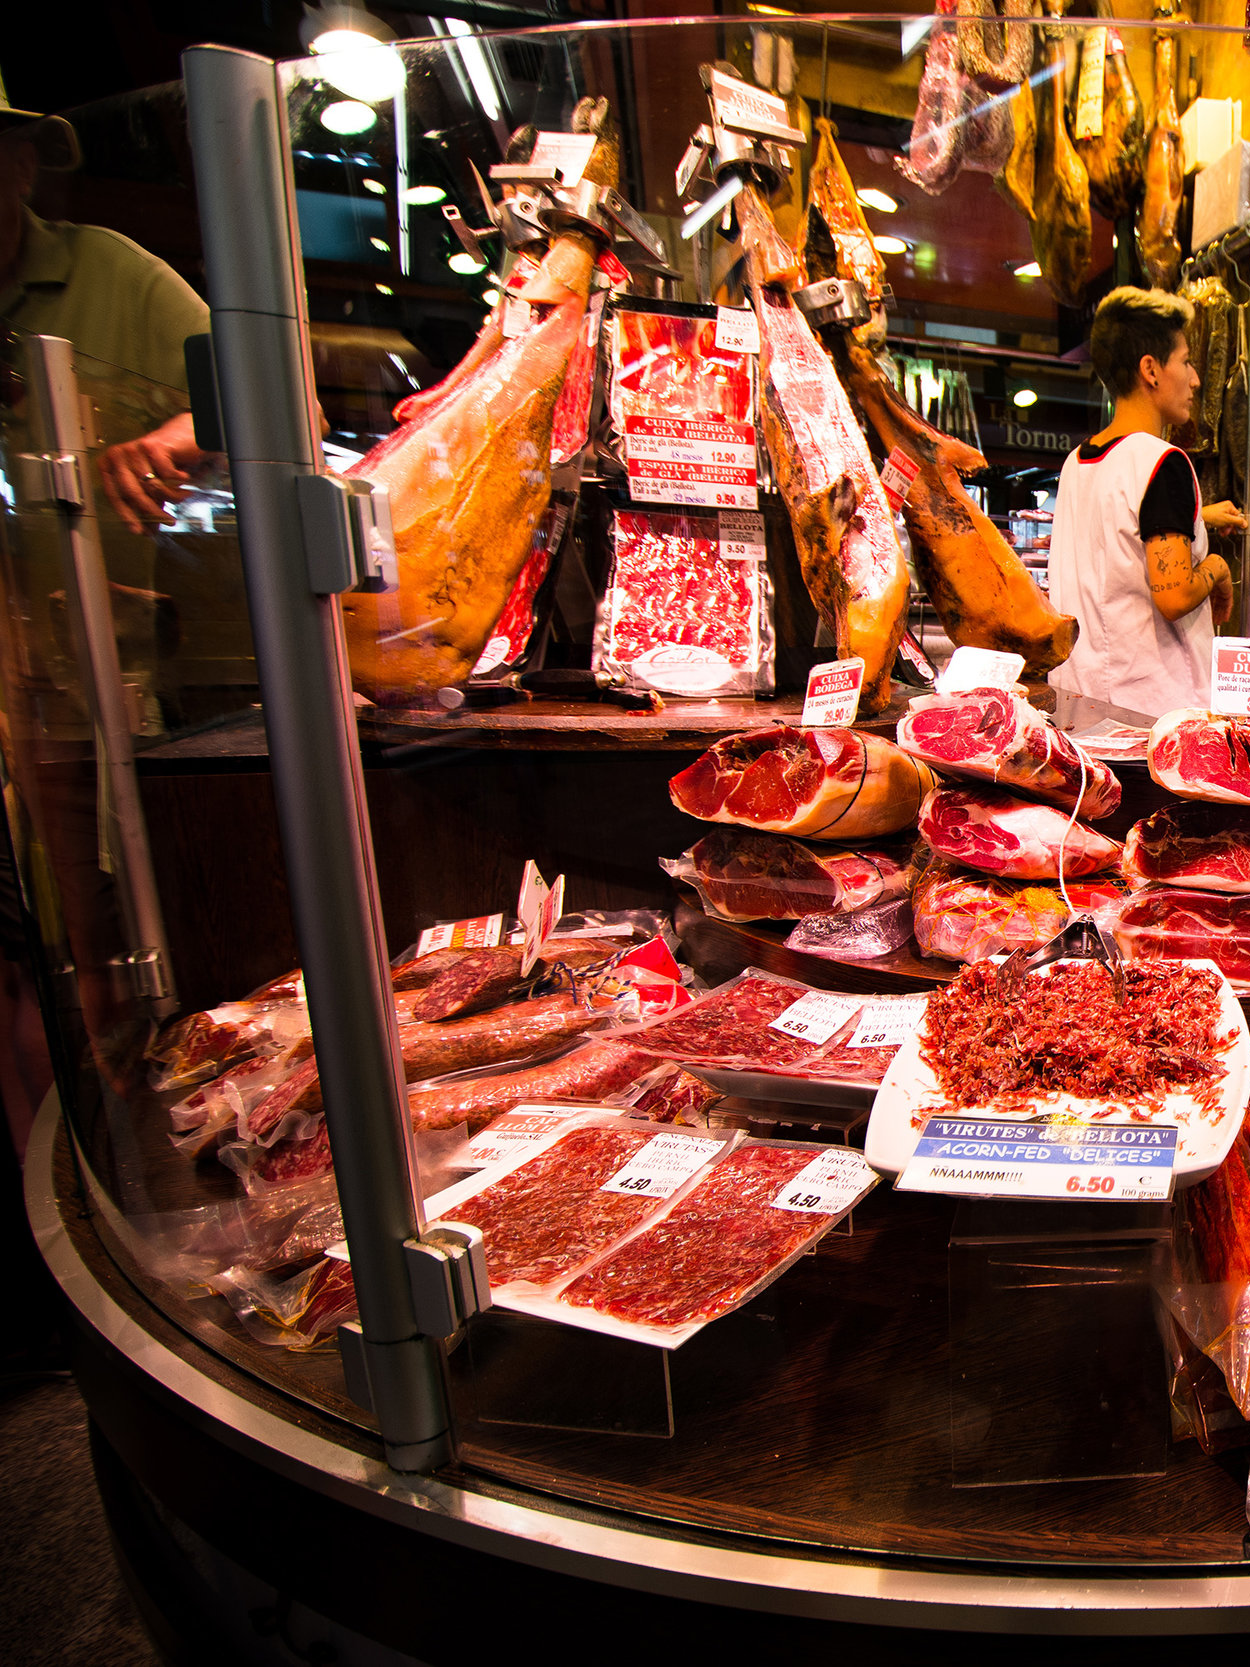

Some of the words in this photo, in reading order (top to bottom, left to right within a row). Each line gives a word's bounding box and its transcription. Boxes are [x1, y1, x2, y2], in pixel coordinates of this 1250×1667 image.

[644, 418, 683, 430] CUIXA
[633, 426, 647, 435] de
[684, 430, 747, 444] (BELLOTA)
[1000, 421, 1072, 451] Torna
[711, 450, 736, 464] 12.90
[638, 460, 696, 473] ESPATLLA
[640, 469, 653, 477] de
[688, 473, 748, 485] (BELLOTA)
[716, 493, 736, 506] 9.50
[720, 523, 764, 532] BELLOTA
[726, 543, 746, 554] 9.50
[821, 671, 850, 685] CUIXA
[814, 680, 854, 695] BODEGA
[823, 707, 845, 724] 29.90
[788, 1007, 838, 1028] BELLOTA
[782, 1020, 809, 1034] 6.50
[860, 1033, 886, 1044] 6.50
[493, 1122, 539, 1132] LLOM
[525, 1116, 559, 1125] CAP
[935, 1122, 1034, 1140] "VIRUTES"
[1038, 1128, 1060, 1142] de
[1064, 1129, 1170, 1145] "BELLOTA"
[937, 1142, 1052, 1160] ACORN-FED
[1061, 1146, 1161, 1164] "DELICES"
[818, 1156, 868, 1170] "VIRUTA
[618, 1177, 652, 1191] 4.50
[1065, 1176, 1116, 1194] 6.50
[787, 1192, 822, 1208] 4.50
[1120, 1188, 1136, 1198] 100
[1138, 1189, 1165, 1199] grams
